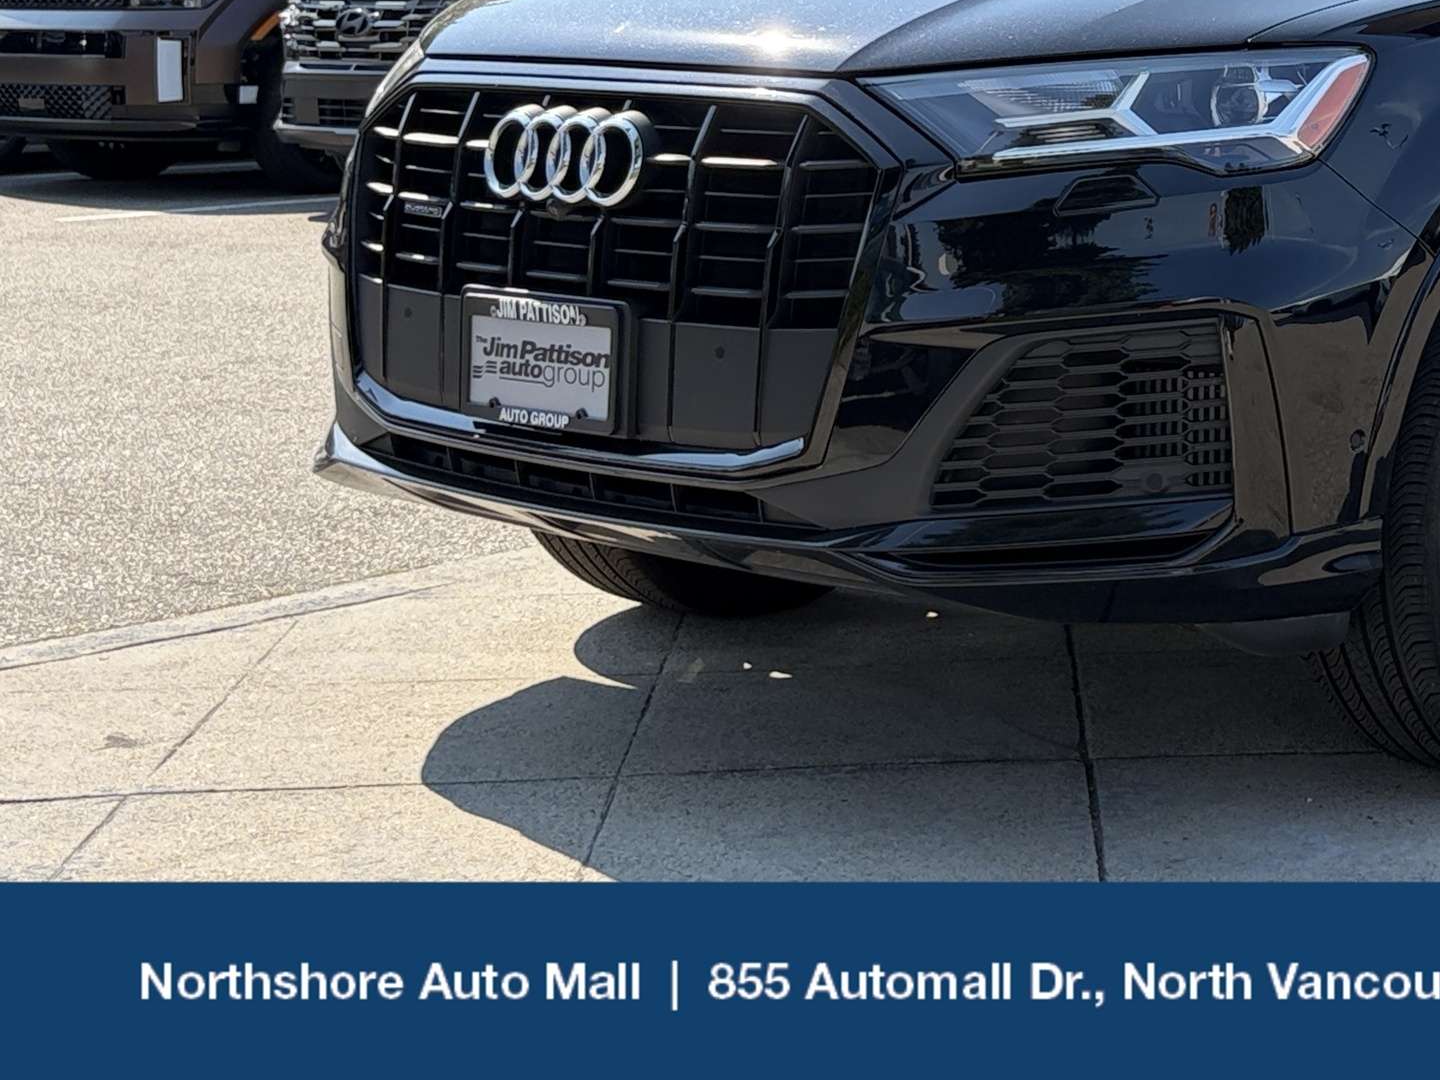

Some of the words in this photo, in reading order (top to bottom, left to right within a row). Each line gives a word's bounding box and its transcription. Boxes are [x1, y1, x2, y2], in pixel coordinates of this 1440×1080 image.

[496, 298, 518, 319] JIM
[520, 300, 581, 326] PATTISON
[499, 407, 529, 424] AUTO
[530, 411, 570, 429] GROUP
